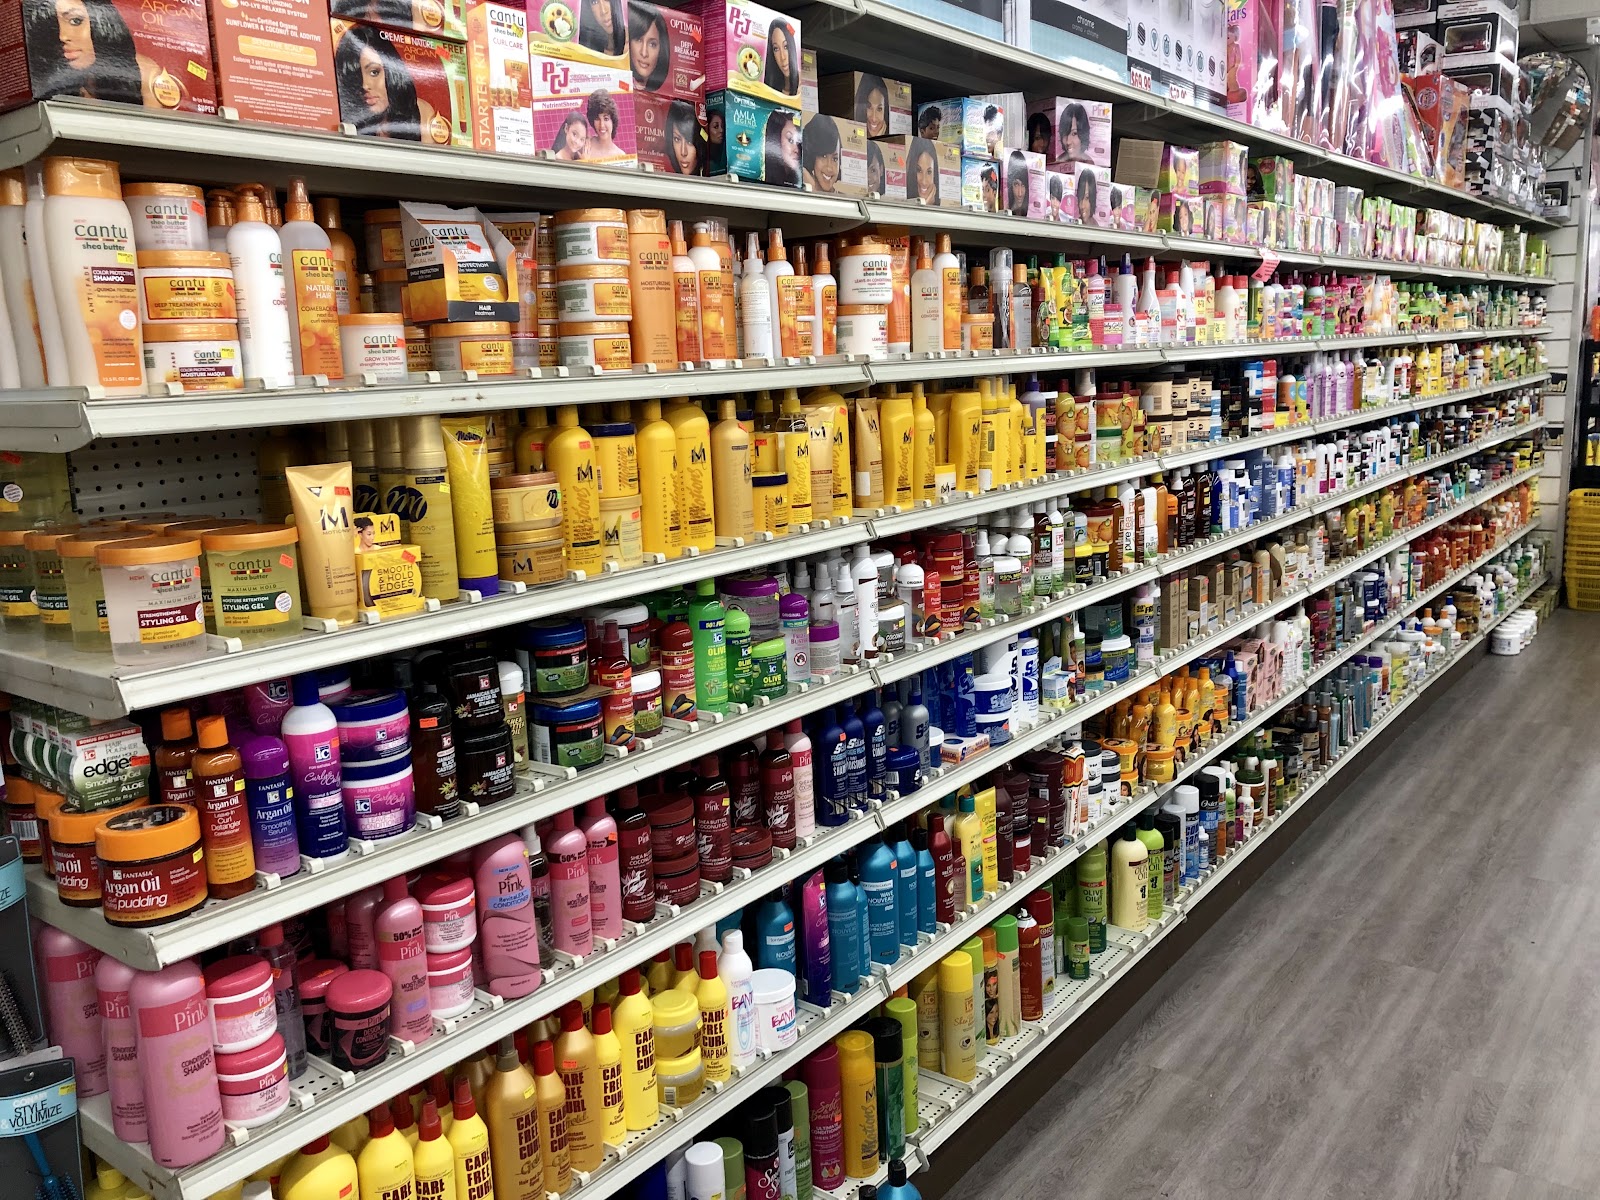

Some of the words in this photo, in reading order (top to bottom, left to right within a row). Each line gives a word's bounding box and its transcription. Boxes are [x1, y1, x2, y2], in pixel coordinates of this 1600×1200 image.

[141, 1, 203, 21] ARGAN
[241, 1, 260, 10] NO-LYE
[262, 4, 285, 14] RELAXER
[287, 9, 307, 19] SYSTEM
[257, 17, 278, 27] Certified
[489, 9, 525, 27] cantu
[1076, 15, 1095, 29] chrome
[225, 18, 259, 31] SUNFLOWER
[266, 25, 291, 36] COCONUT
[300, 32, 321, 42] ADDITIVE
[494, 28, 506, 36] shea
[670, 19, 702, 34] OPTIMUM
[380, 30, 405, 44] CREME
[411, 37, 435, 49] NATURE
[493, 37, 508, 47] CURL
[509, 40, 524, 50] CARE
[681, 41, 693, 49] DEFY
[403, 46, 438, 58] ARGAN
[443, 42, 464, 54] FREE
[674, 45, 699, 58] BREAKAGE
[404, 53, 419, 62] OIL
[473, 40, 485, 69] KIT
[542, 62, 570, 94] PCJ
[198, 105, 215, 113] SUPER
[475, 76, 491, 147] STARTER
[734, 109, 756, 120] AMLA
[734, 116, 756, 128] LEGEND
[635, 125, 665, 137] OPTIMUM
[145, 204, 188, 215] cantu
[75, 223, 128, 239] cantu
[431, 226, 468, 238] cantu
[82, 242, 102, 250] shea
[103, 243, 125, 251] butter
[409, 236, 434, 248] cantu
[639, 251, 669, 260] cantu
[863, 259, 887, 268] cantu
[93, 269, 109, 277] COLOR
[170, 279, 205, 287] cantu
[364, 334, 397, 345] cantu
[481, 342, 504, 350] cantu
[194, 351, 221, 359] cantu
[1124, 531, 1134, 550] pure
[228, 558, 272, 570] cantu
[378, 564, 413, 576] SMOOTH
[151, 568, 192, 582] cantu
[385, 572, 414, 583] HOLD
[174, 584, 190, 592] butter
[379, 580, 414, 592] EDGES
[148, 598, 180, 606] MAXIMUM
[222, 603, 248, 612] STYLING
[251, 602, 265, 610] GEL
[139, 610, 181, 618] STRENGTHENING
[949, 610, 960, 618] Heat
[140, 616, 168, 628] STYLING
[172, 614, 189, 623] GEL
[763, 674, 781, 684] OLIVE
[466, 691, 489, 700] JAMAICAN
[105, 741, 122, 749] HAIR
[105, 743, 138, 754] POLISHER
[85, 774, 124, 789] Smoothing
[126, 770, 141, 779] Gel
[483, 768, 504, 779] JAMAICAN
[781, 772, 792, 782] Pink
[121, 782, 145, 792] ALOE
[206, 776, 234, 786] FANTASIA
[258, 781, 285, 791] FANTASIA
[207, 800, 228, 810] Argan
[229, 796, 239, 806] Oil
[705, 802, 720, 811] Pink
[256, 807, 282, 821] Argan
[283, 804, 292, 815] Oil
[211, 819, 241, 830] Detangler
[217, 816, 232, 824] Curl
[261, 819, 292, 831] Smoothing
[268, 826, 288, 835] Serum
[561, 854, 576, 863] 50%
[65, 859, 81, 873] Oil
[567, 865, 586, 879] Pink
[1149, 862, 1161, 871] OIL
[123, 870, 153, 879] FANTASIA
[105, 878, 139, 897] Argan
[141, 876, 161, 890] Oil
[498, 880, 524, 894] Pink
[656, 881, 668, 890] Pink
[1083, 889, 1103, 897] OLIVE
[117, 894, 168, 910] pudding
[493, 895, 529, 909] CONDITIONER
[868, 896, 894, 904] NOUVEAU
[444, 912, 460, 921] Pink
[393, 929, 412, 942] 50%
[401, 945, 423, 960] Pink
[259, 993, 271, 1006] Pink
[106, 1001, 130, 1018] Pin
[173, 1003, 206, 1032] Pink
[367, 1015, 383, 1026] Pink
[701, 1010, 725, 1023] CARE
[363, 1026, 381, 1036] DESIGN
[702, 1022, 723, 1035] FREE
[702, 1034, 726, 1047] CURL
[636, 1043, 655, 1057] FREE
[701, 1048, 714, 1059] SNAP
[715, 1046, 728, 1058] BACK
[183, 1058, 212, 1077] SHAMPOO
[259, 1077, 277, 1088] Pink
[604, 1081, 623, 1094] FREE
[265, 1093, 276, 1101] JAM
[14, 1101, 47, 1118] STYLE
[820, 1100, 838, 1113] Soft
[1, 1118, 9, 1129] &
[9, 1104, 62, 1129] VOLUMIZE
[816, 1124, 838, 1133] ULTIMATE
[518, 1125, 539, 1145] FREE
[465, 1147, 490, 1171] CARE
[467, 1165, 490, 1186] FREE
[416, 1179, 445, 1195] CARE
